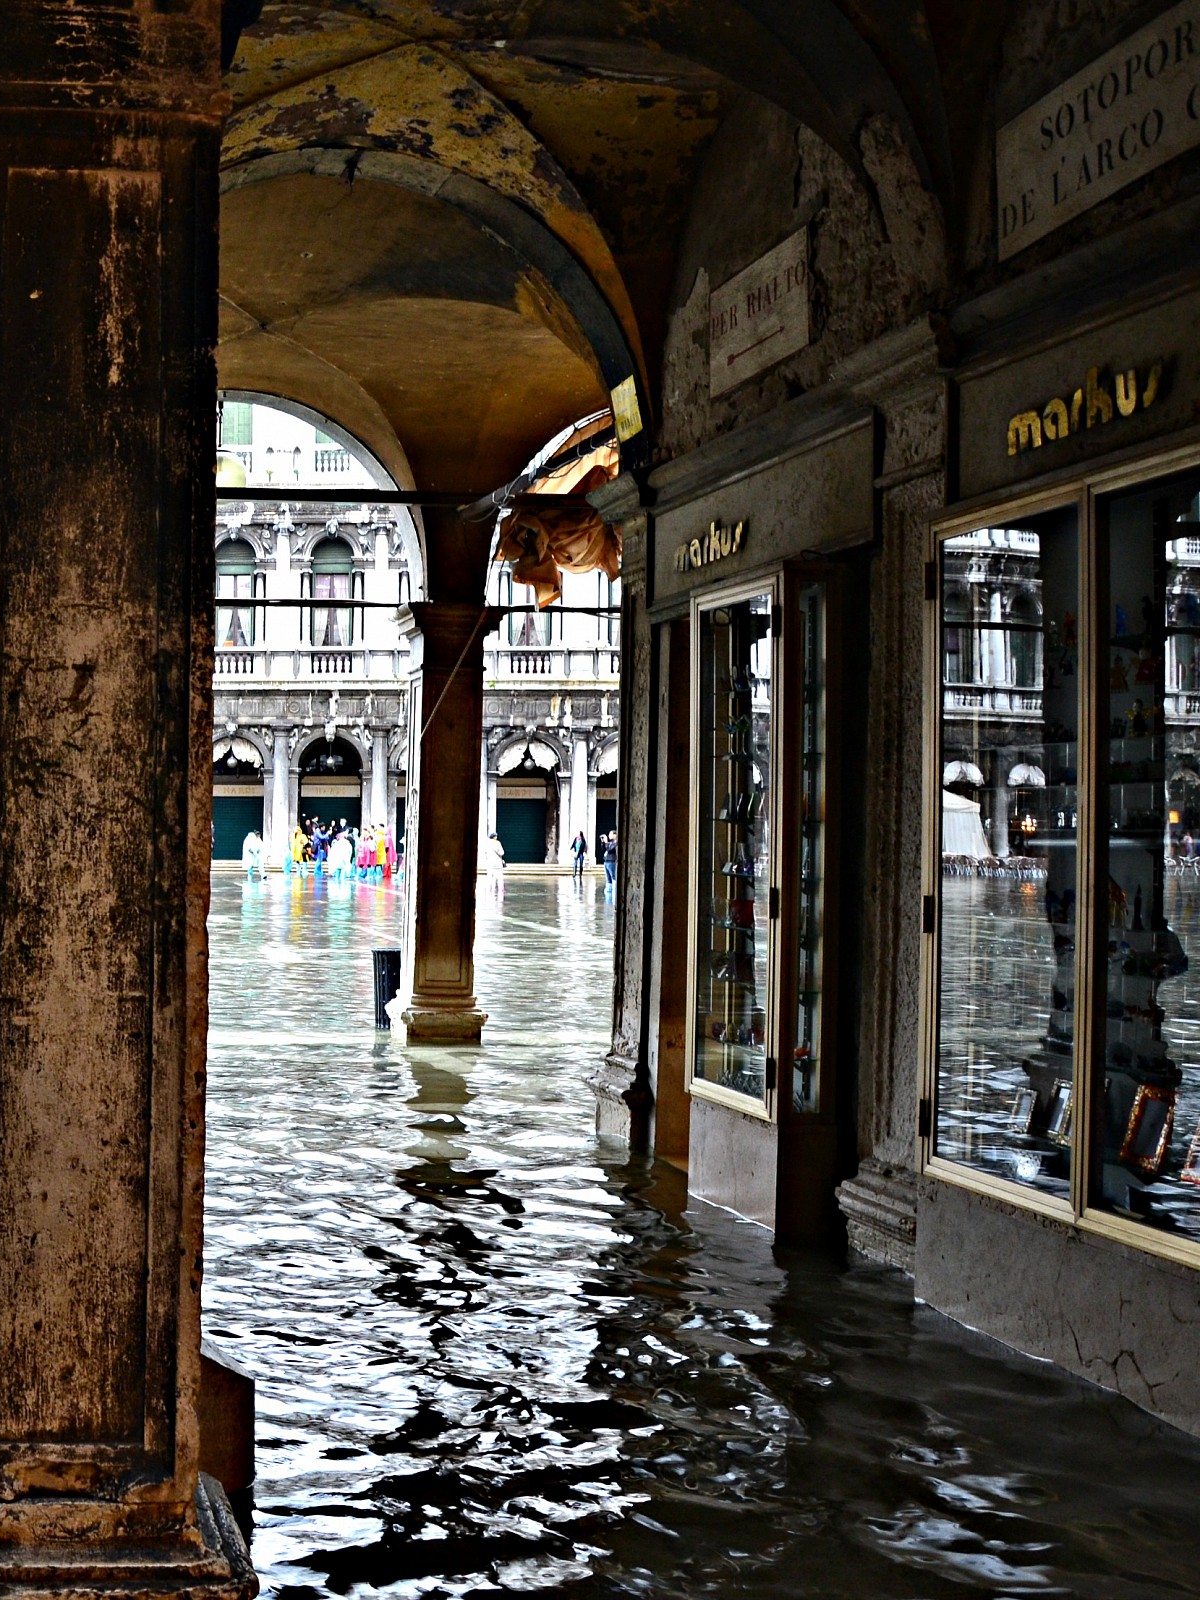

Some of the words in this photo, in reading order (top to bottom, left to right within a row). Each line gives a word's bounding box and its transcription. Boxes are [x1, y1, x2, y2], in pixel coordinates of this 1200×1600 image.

[1040, 20, 1194, 151] SOTOPOR
[1002, 189, 1036, 238] DE
[711, 304, 738, 341] PER
[747, 260, 806, 319] RIALTO
[1006, 361, 1164, 458] markus
[674, 520, 744, 572] markus
